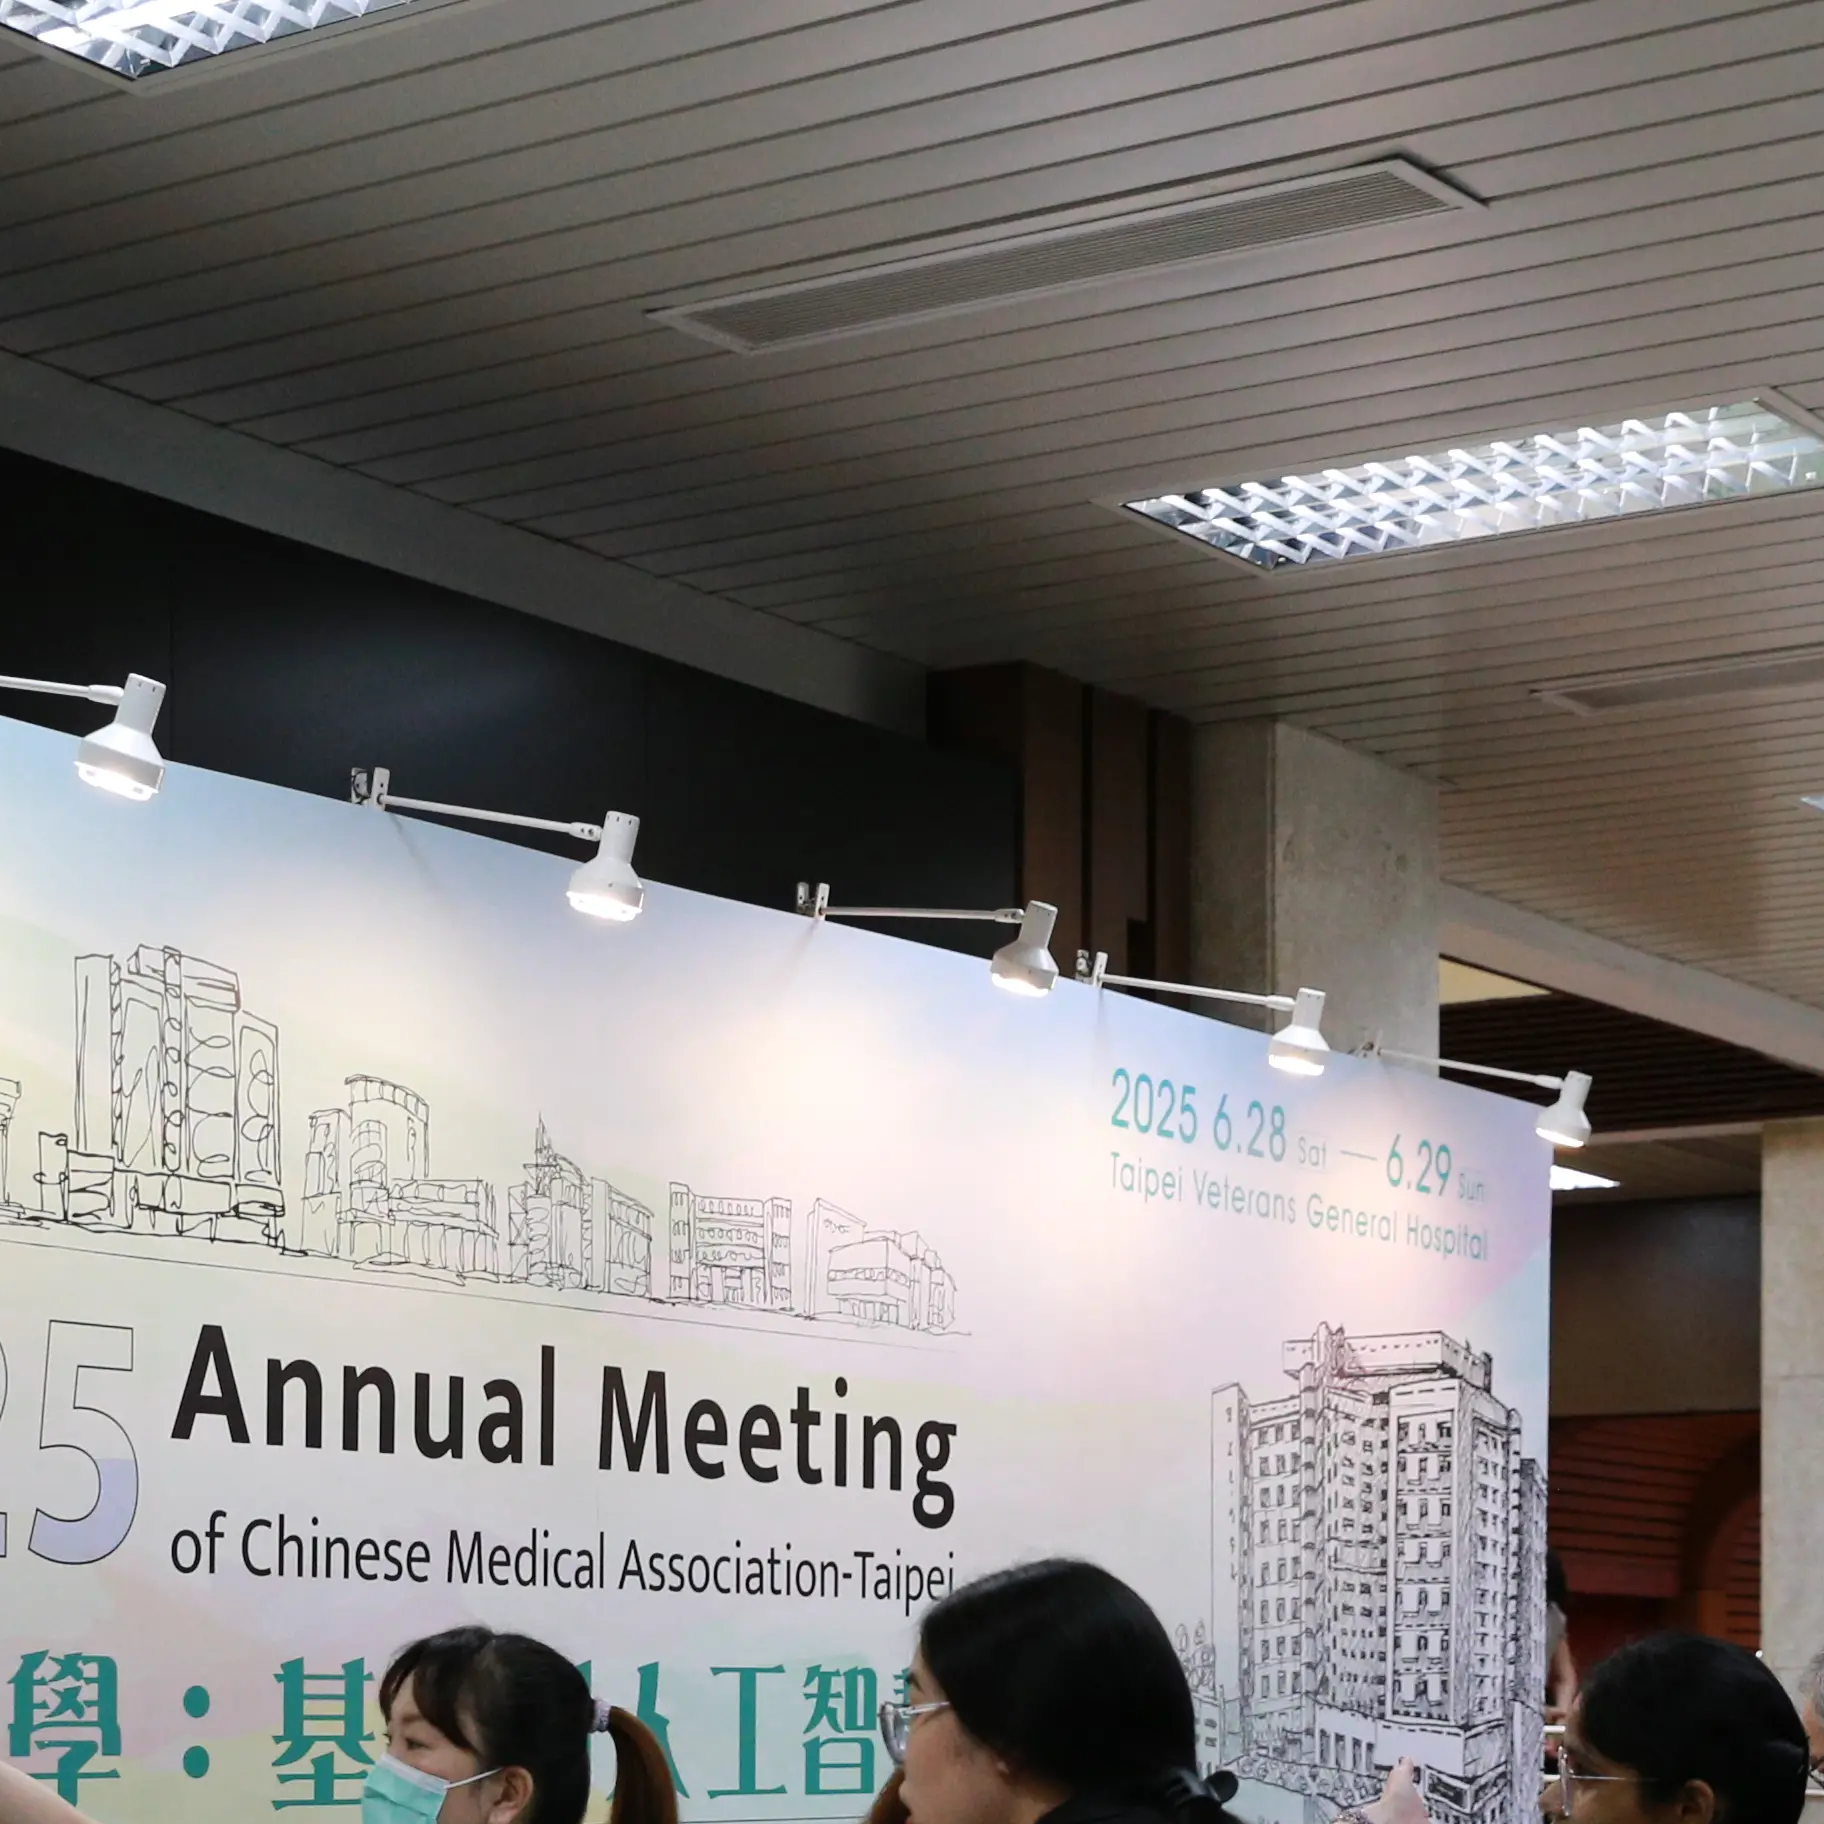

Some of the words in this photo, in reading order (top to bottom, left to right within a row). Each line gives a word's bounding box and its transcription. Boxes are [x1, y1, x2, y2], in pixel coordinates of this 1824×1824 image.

[1111, 1067, 1198, 1144] 2025
[1213, 1093, 1287, 1163] 6.28
[1297, 1136, 1328, 1169] Sat
[1386, 1133, 1453, 1197] 6.29
[1459, 1172, 1485, 1203] Sun
[1111, 1151, 1183, 1203] Taipei
[1193, 1169, 1297, 1224] Veterans
[1307, 1193, 1398, 1243] General
[1407, 1216, 1488, 1261] Hospital
[171, 1324, 556, 1467] Annual
[598, 1364, 958, 1529] Meeting
[171, 1511, 227, 1575] of
[241, 1517, 431, 1584] Chinese
[447, 1528, 605, 1590] Medical
[619, 1538, 954, 1617] Association-Taipei
